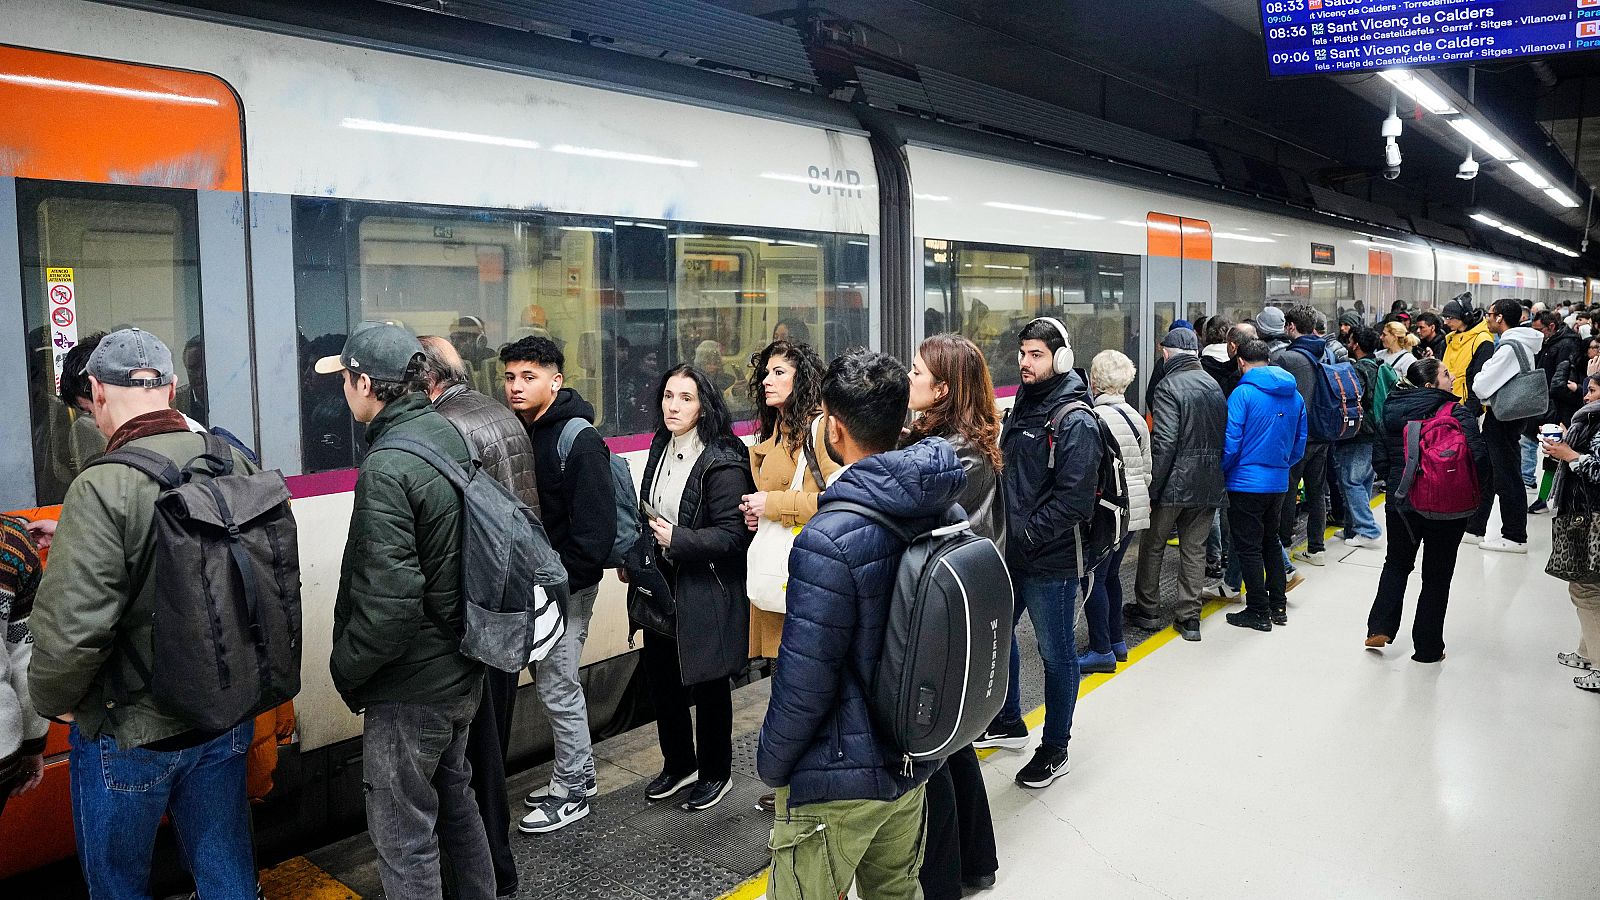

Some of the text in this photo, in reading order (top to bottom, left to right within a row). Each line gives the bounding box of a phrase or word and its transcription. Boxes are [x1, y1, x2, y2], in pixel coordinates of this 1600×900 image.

[1266, 0, 1304, 13] 08:33
[1268, 15, 1292, 23] 09:06
[1317, 10, 1346, 19] Vicenç
[1348, 7, 1359, 15] de
[1361, 4, 1396, 13] Calders
[1269, 7, 1494, 39] 08:36 R2 Sant Vicenç de Calders
[1333, 34, 1358, 44] Platja
[1360, 33, 1371, 41] de
[1373, 26, 1434, 40] Castelldefels
[1442, 23, 1473, 33] Garraf
[1480, 19, 1512, 29] Sitges
[1520, 13, 1566, 25] Vilanova
[1272, 35, 1494, 64] 09:06 R2 Sant Vicenç de Calders
[1336, 60, 1360, 70] Platja
[1363, 59, 1373, 67] de
[1375, 53, 1435, 66] Castelldefels
[1443, 50, 1473, 60] Garraf
[1481, 47, 1512, 57] Sitges
[1520, 42, 1565, 53] Vilanova
